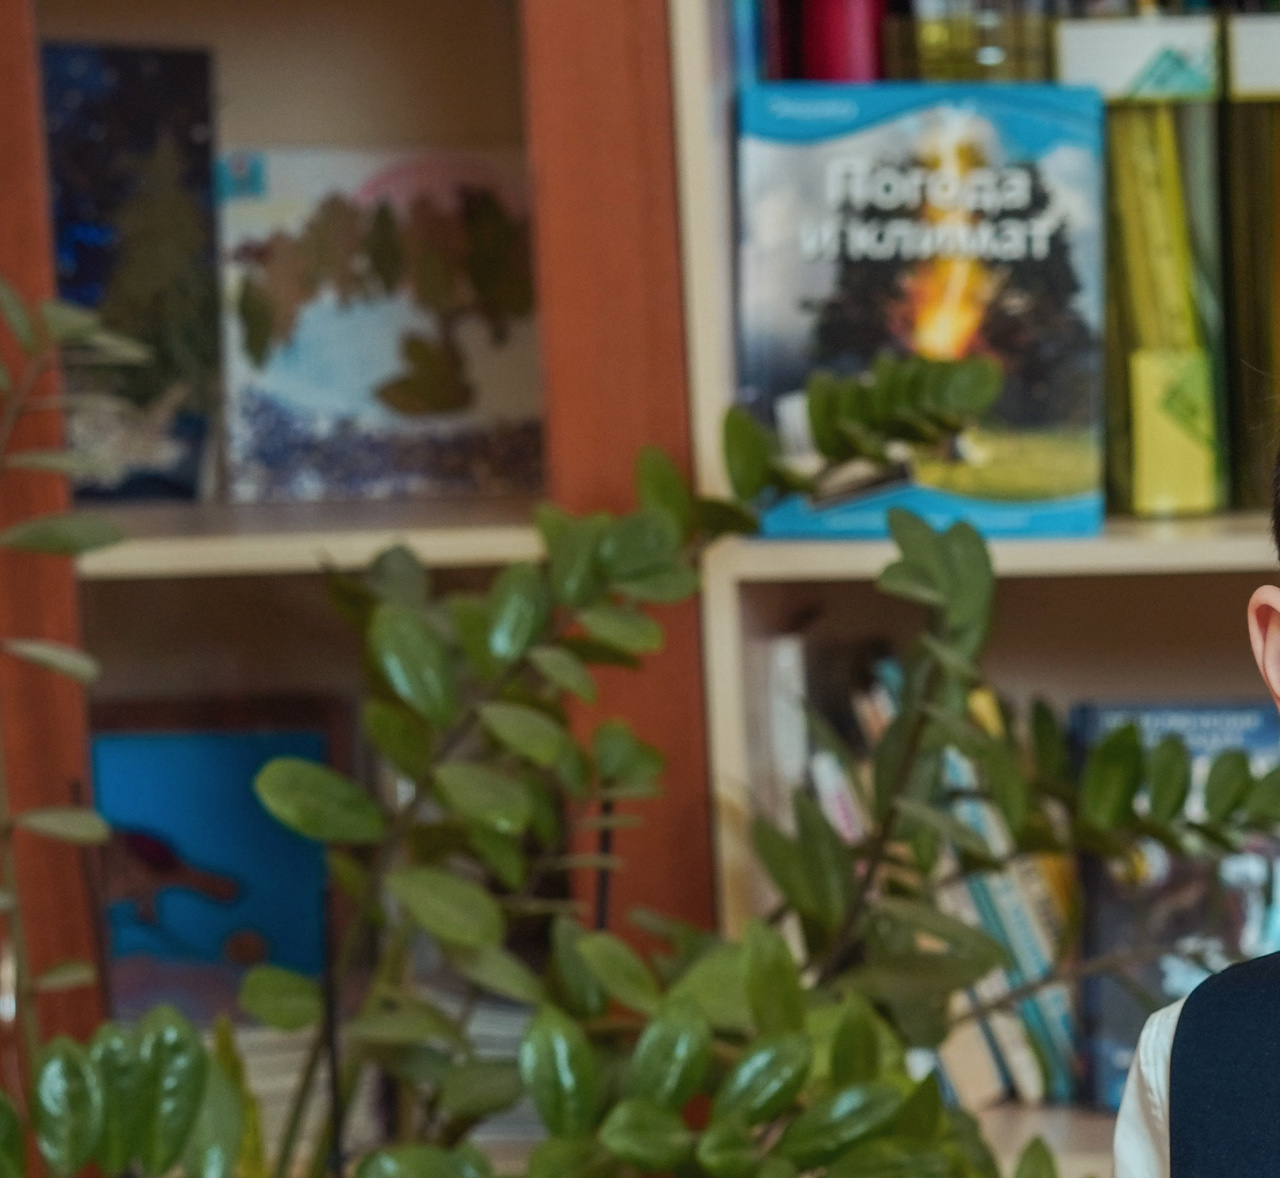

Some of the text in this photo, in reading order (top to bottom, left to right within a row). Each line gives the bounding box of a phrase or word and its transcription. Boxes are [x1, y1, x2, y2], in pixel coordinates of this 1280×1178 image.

[825, 155, 1034, 213] Погода
[801, 216, 1053, 262] и климат
